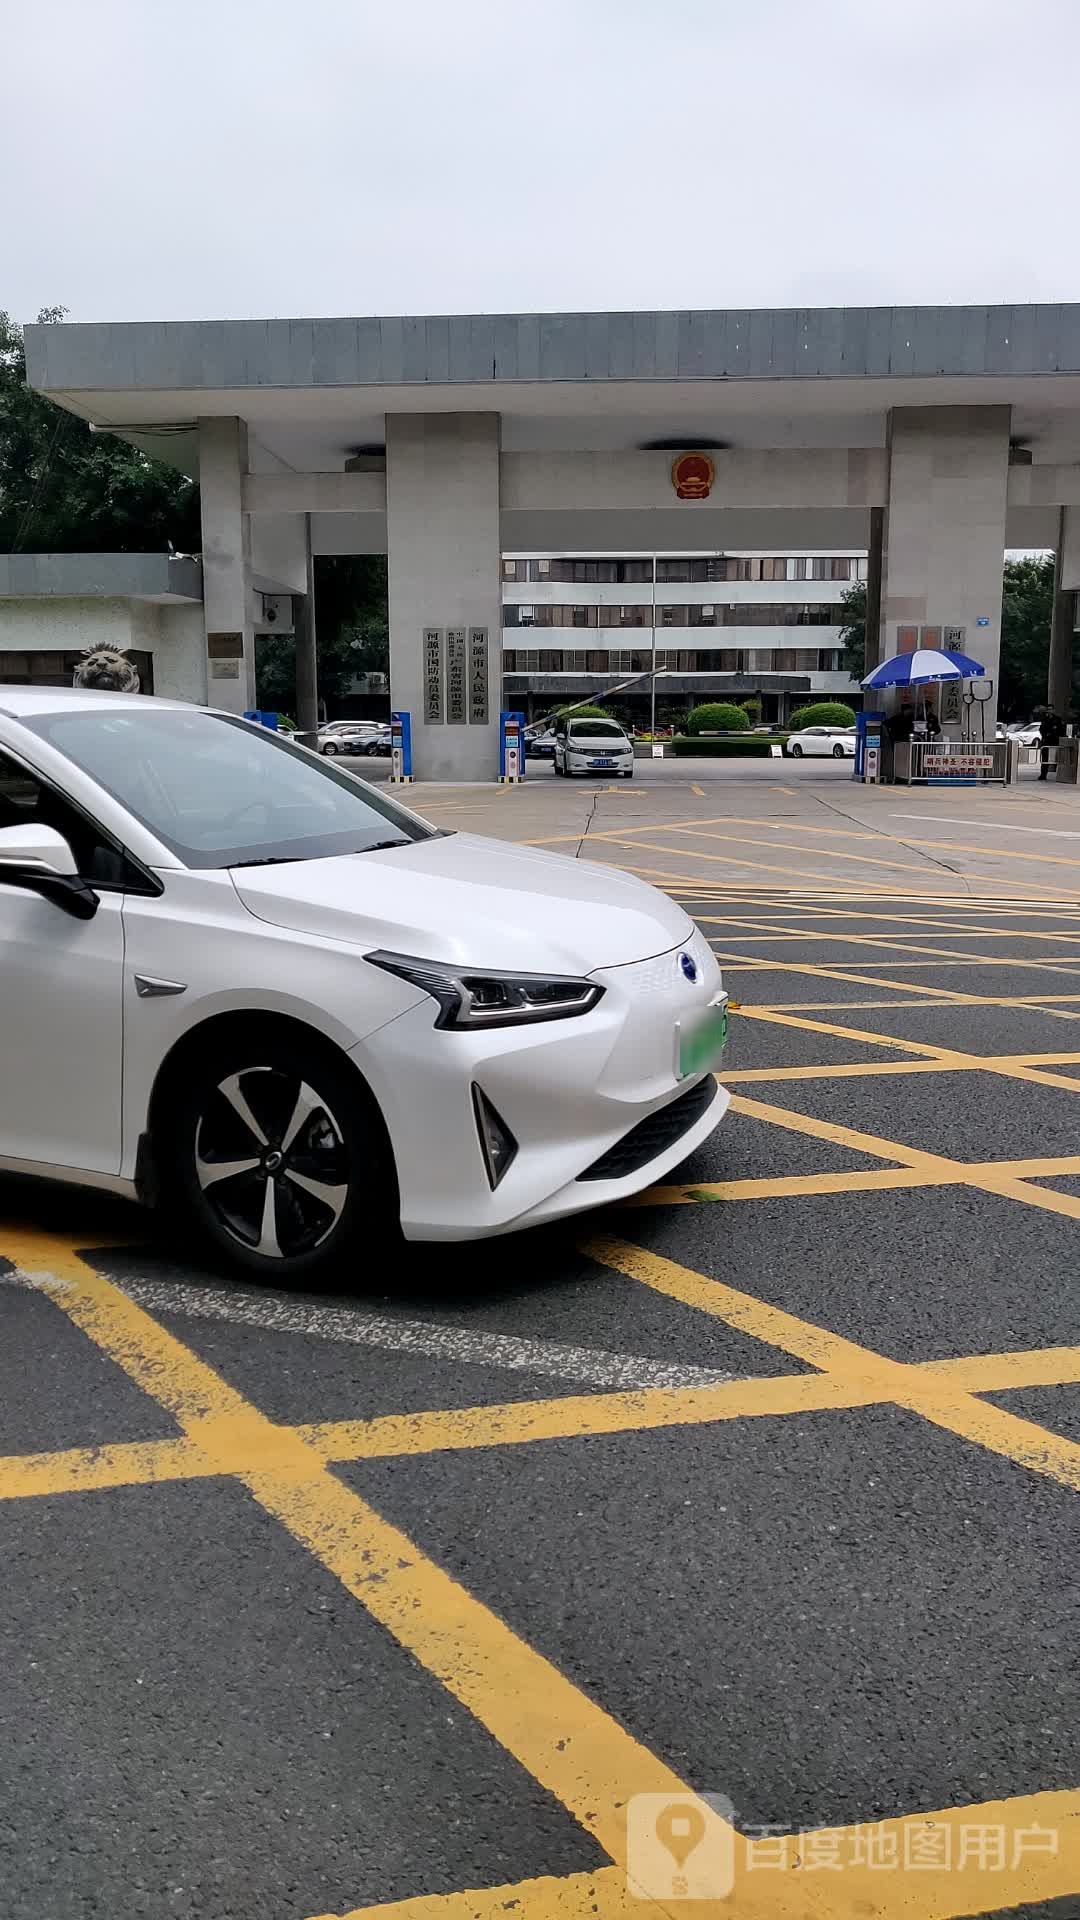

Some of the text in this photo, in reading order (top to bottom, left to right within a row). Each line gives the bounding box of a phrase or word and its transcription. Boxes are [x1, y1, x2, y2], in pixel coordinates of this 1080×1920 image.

[427, 632, 440, 719] 河源市国防动员委员会
[472, 633, 485, 718] 河源市人民政府
